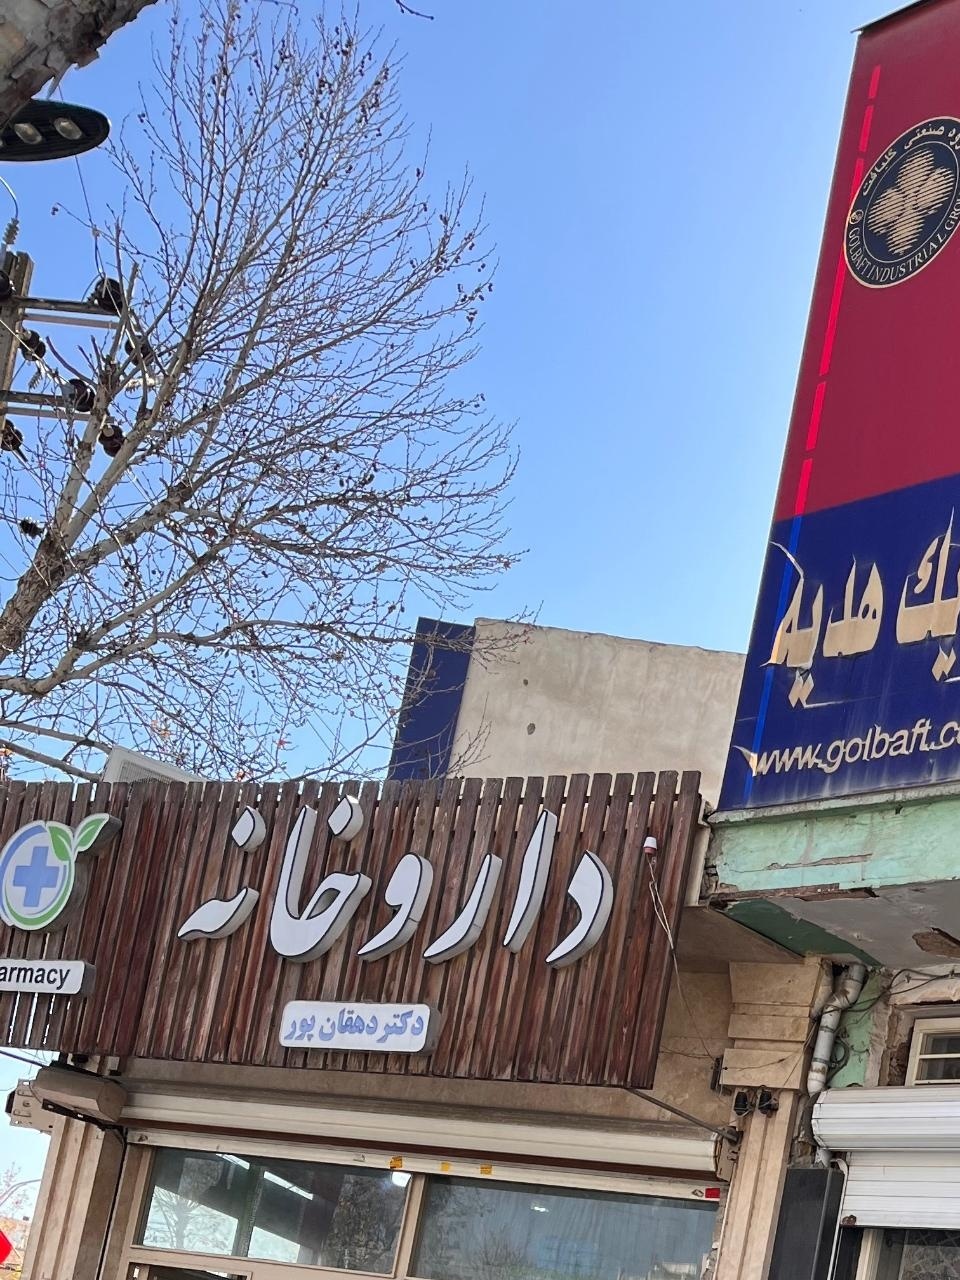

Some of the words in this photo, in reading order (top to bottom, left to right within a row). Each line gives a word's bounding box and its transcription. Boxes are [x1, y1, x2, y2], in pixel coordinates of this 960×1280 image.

[848, 227, 872, 275] GOLBAFT
[867, 233, 947, 283] INDUSTRIAL
[764, 556, 884, 708] هدیه
[177, 794, 614, 969] داروخانه
[283, 1014, 316, 1042] پور
[318, 1007, 379, 1041] دهقان
[375, 1010, 424, 1044] دکتر
